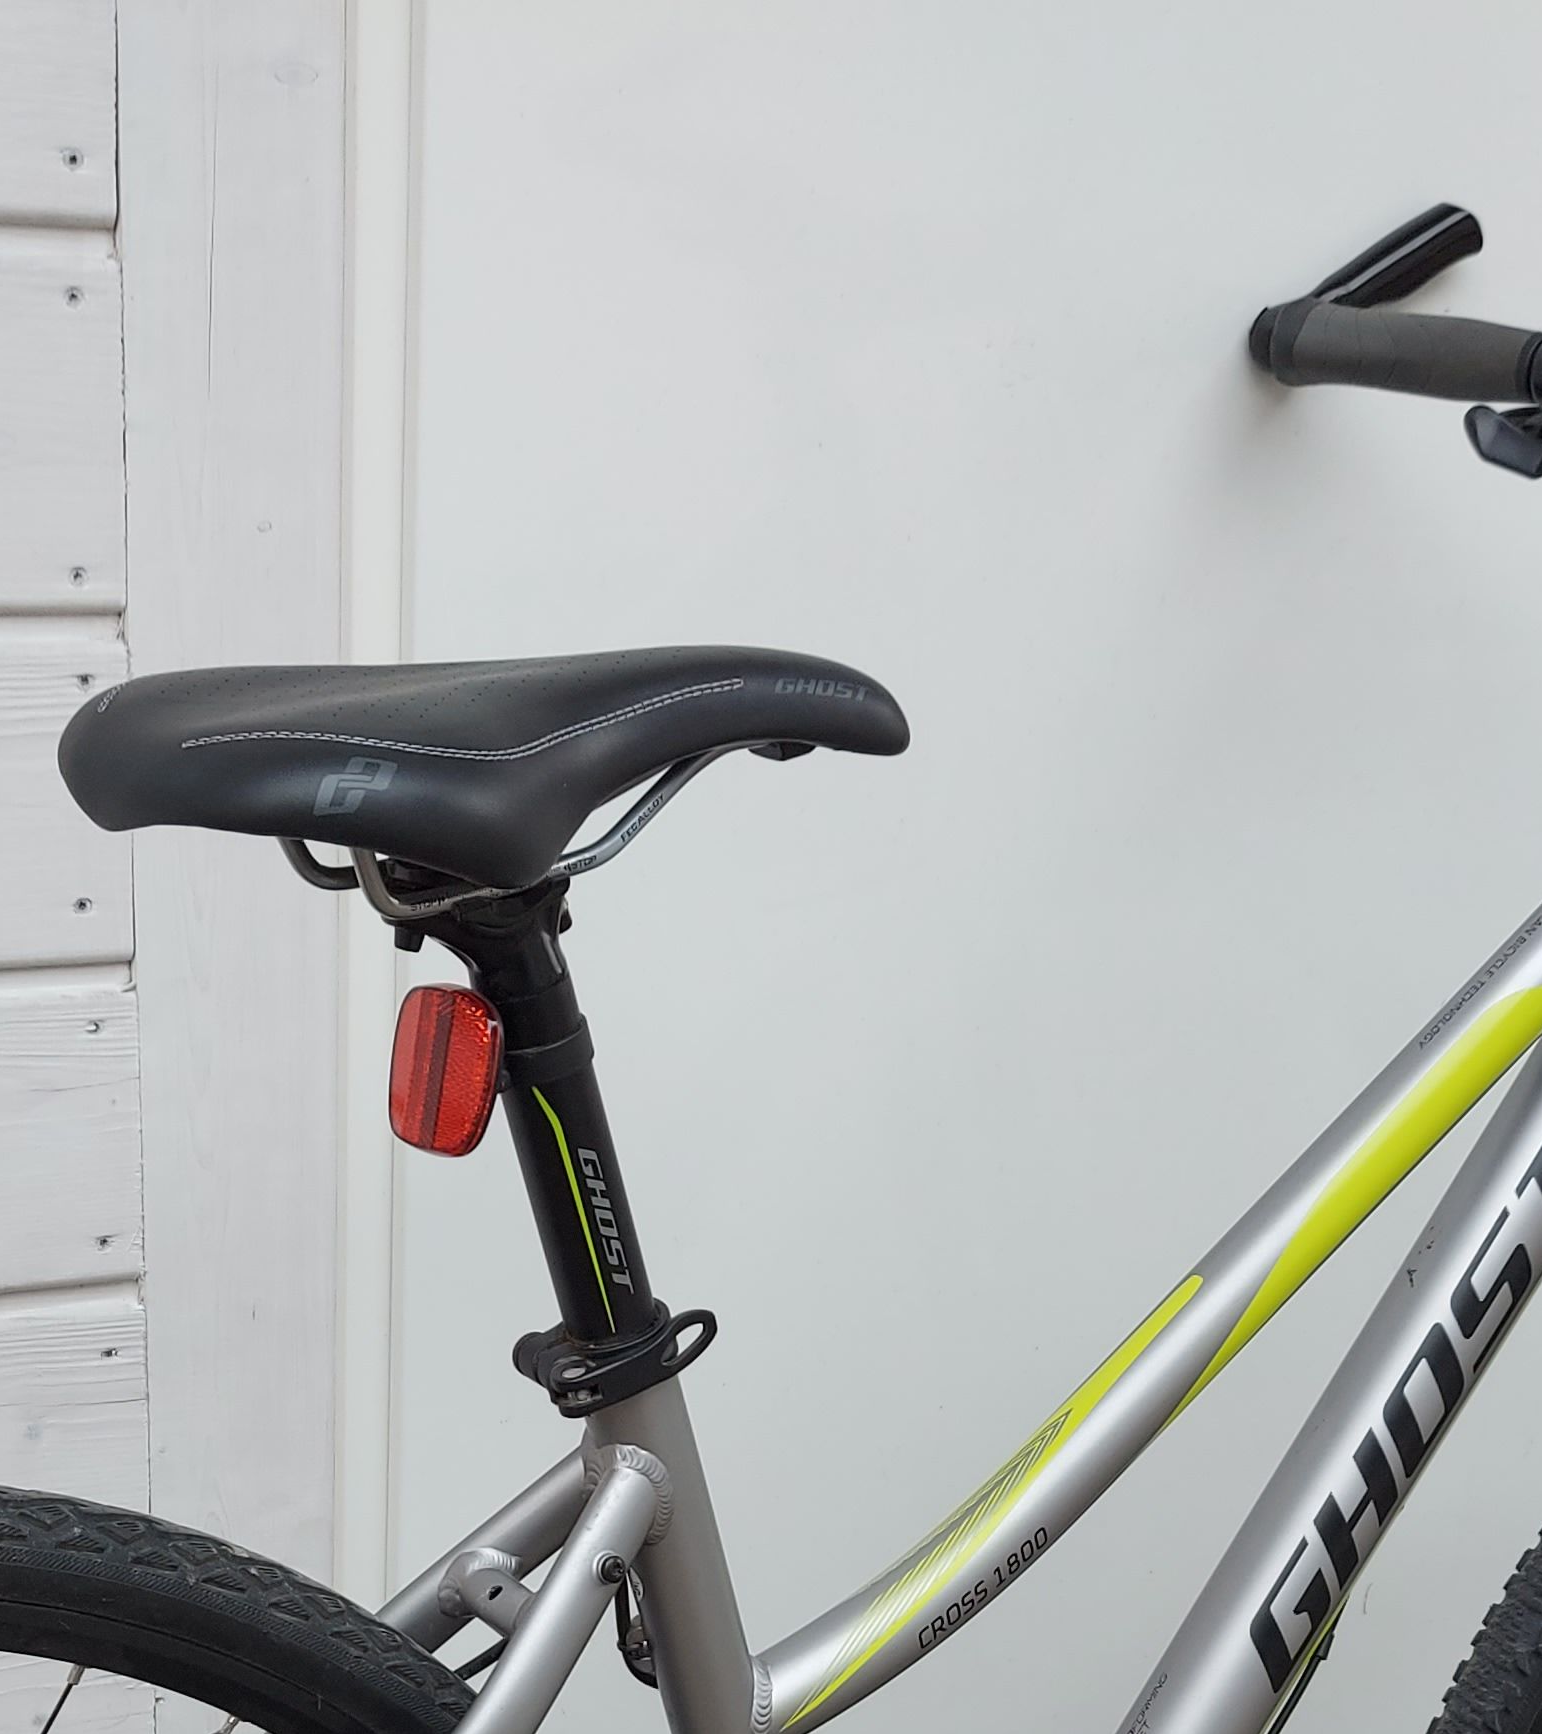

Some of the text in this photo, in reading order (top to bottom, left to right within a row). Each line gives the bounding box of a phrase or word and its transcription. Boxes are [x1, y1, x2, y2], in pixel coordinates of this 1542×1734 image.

[774, 678, 871, 702] GHOST
[1485, 935, 1527, 978] BICYCLE
[1419, 980, 1486, 1049] TECHNOLOGY
[577, 1147, 635, 1295] GHOST
[918, 1526, 1049, 1649] CROSS 1800
